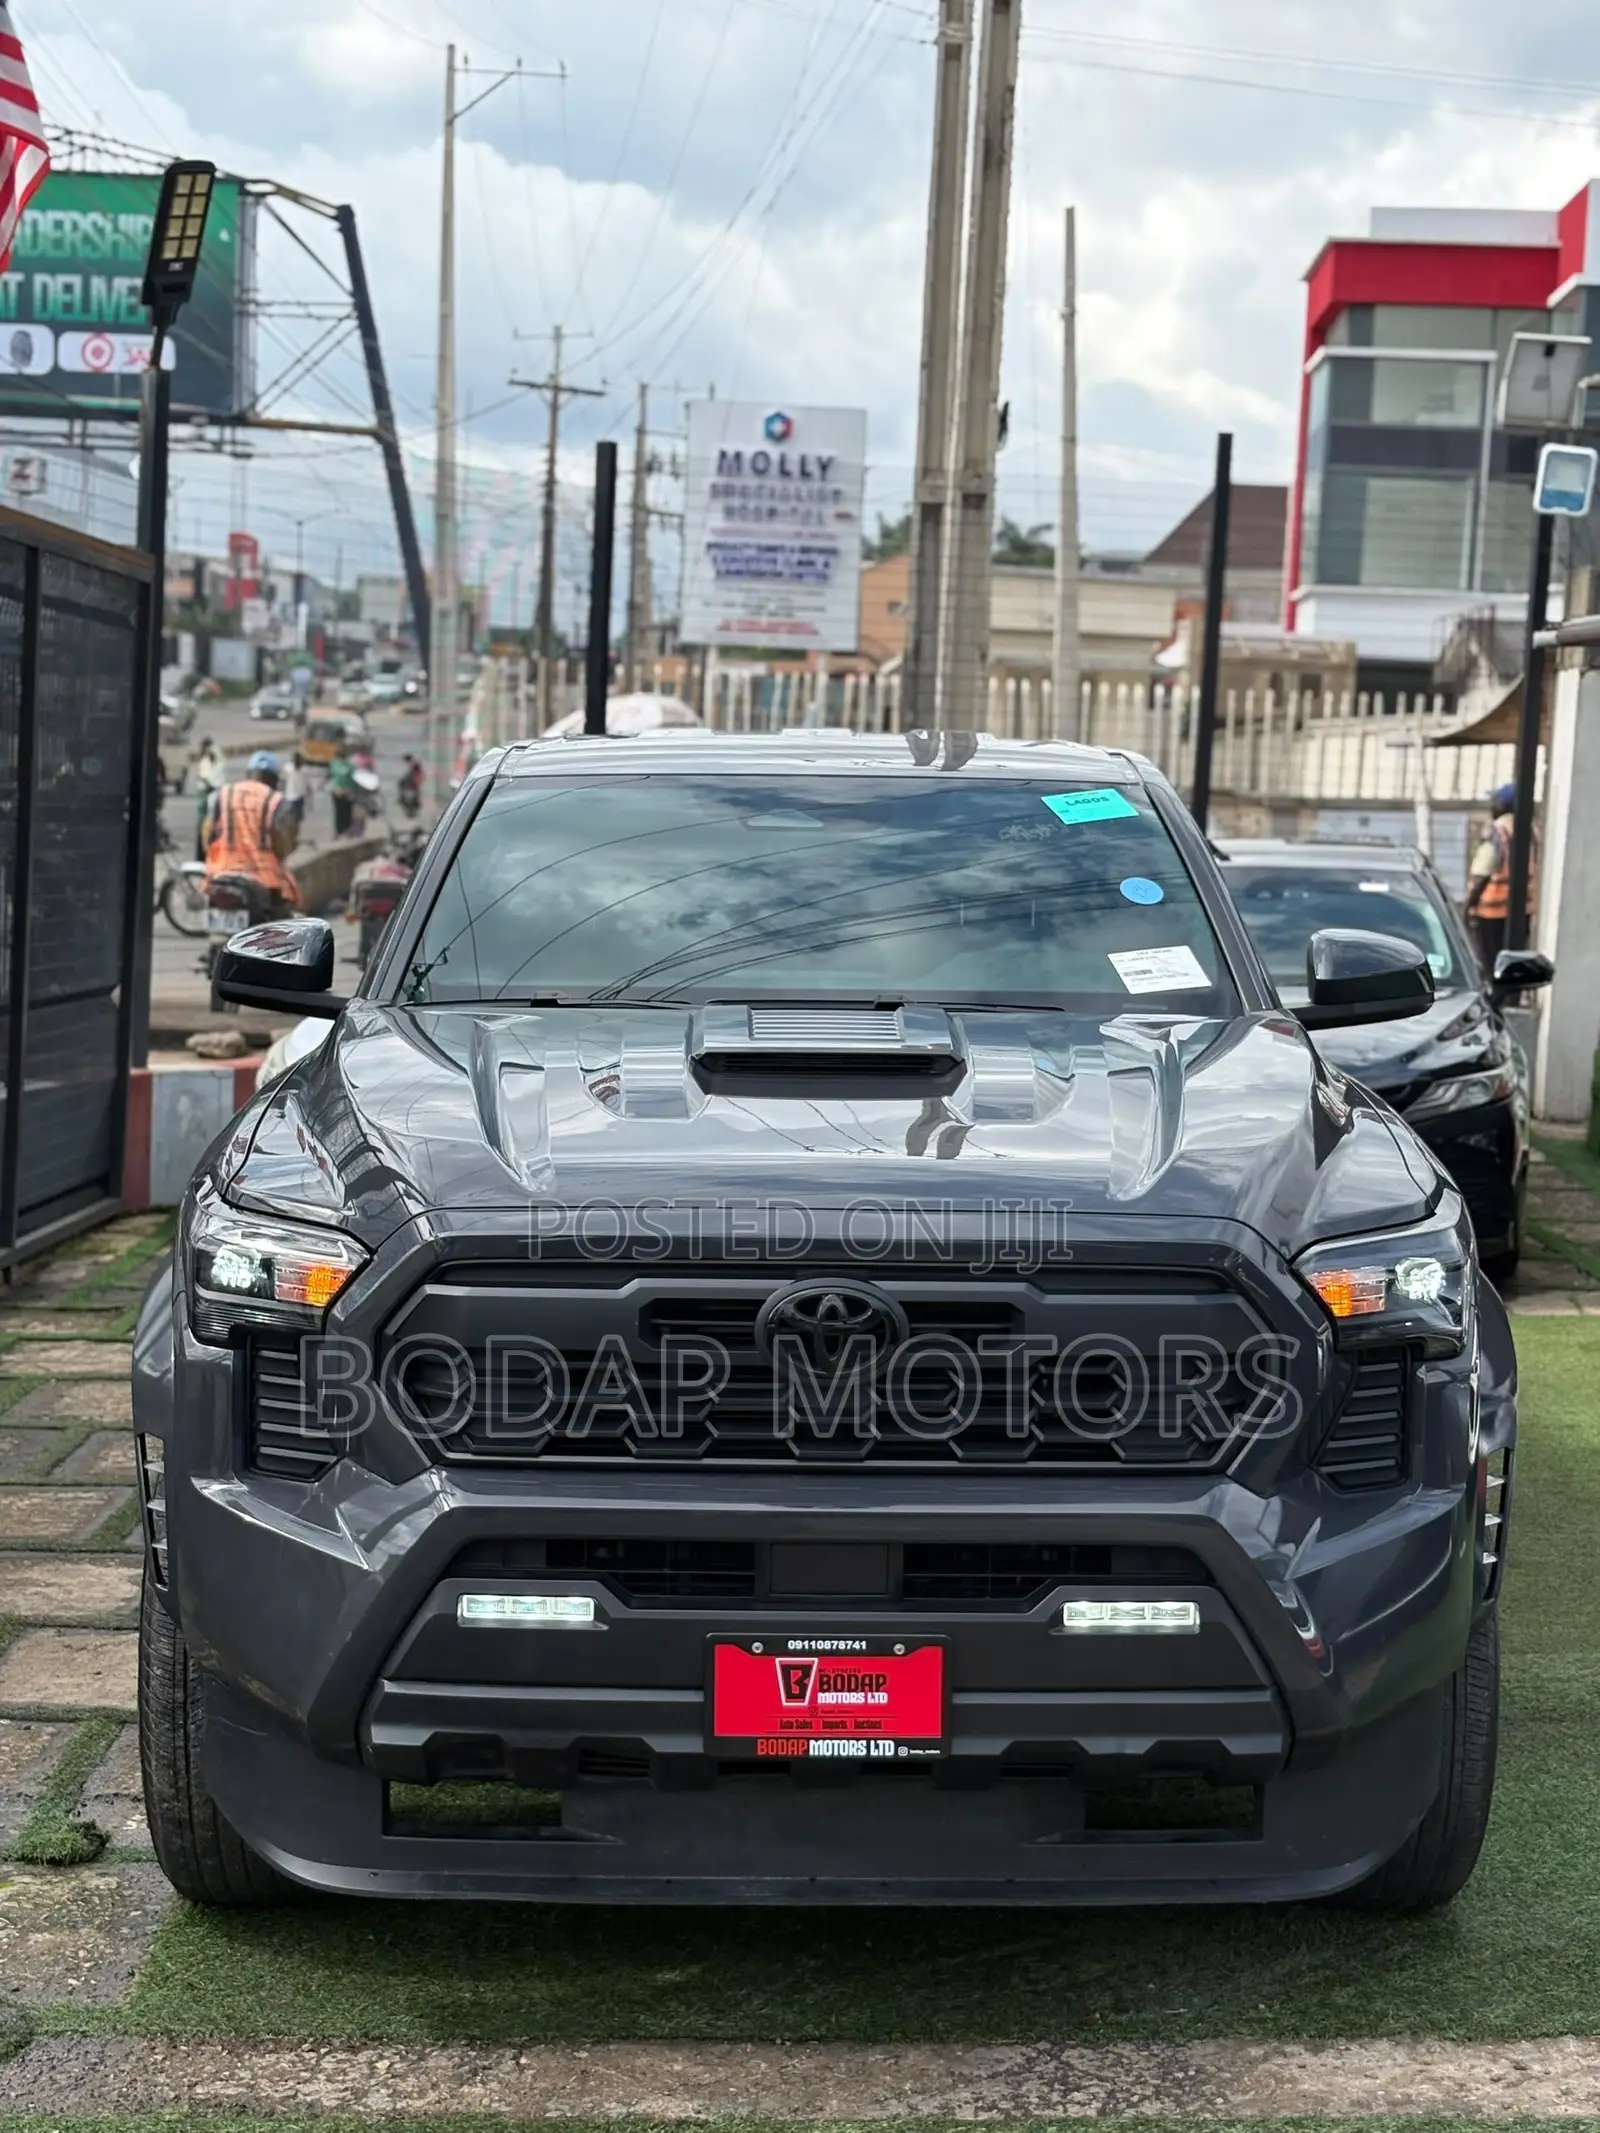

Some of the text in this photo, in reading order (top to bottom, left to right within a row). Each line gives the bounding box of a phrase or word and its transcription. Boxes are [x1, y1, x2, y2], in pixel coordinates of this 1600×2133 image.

[12, 209, 153, 260] DERSHIP
[32, 272, 146, 323] DELIVE
[717, 449, 836, 481] MOLLY
[1065, 796, 1110, 806] LAGOS
[787, 1640, 867, 1650] 09110878741
[818, 1673, 888, 1692] BODAP
[817, 1692, 888, 1704] MOTORS LTD
[757, 1739, 895, 1756] BODAP MOTORS LTD
